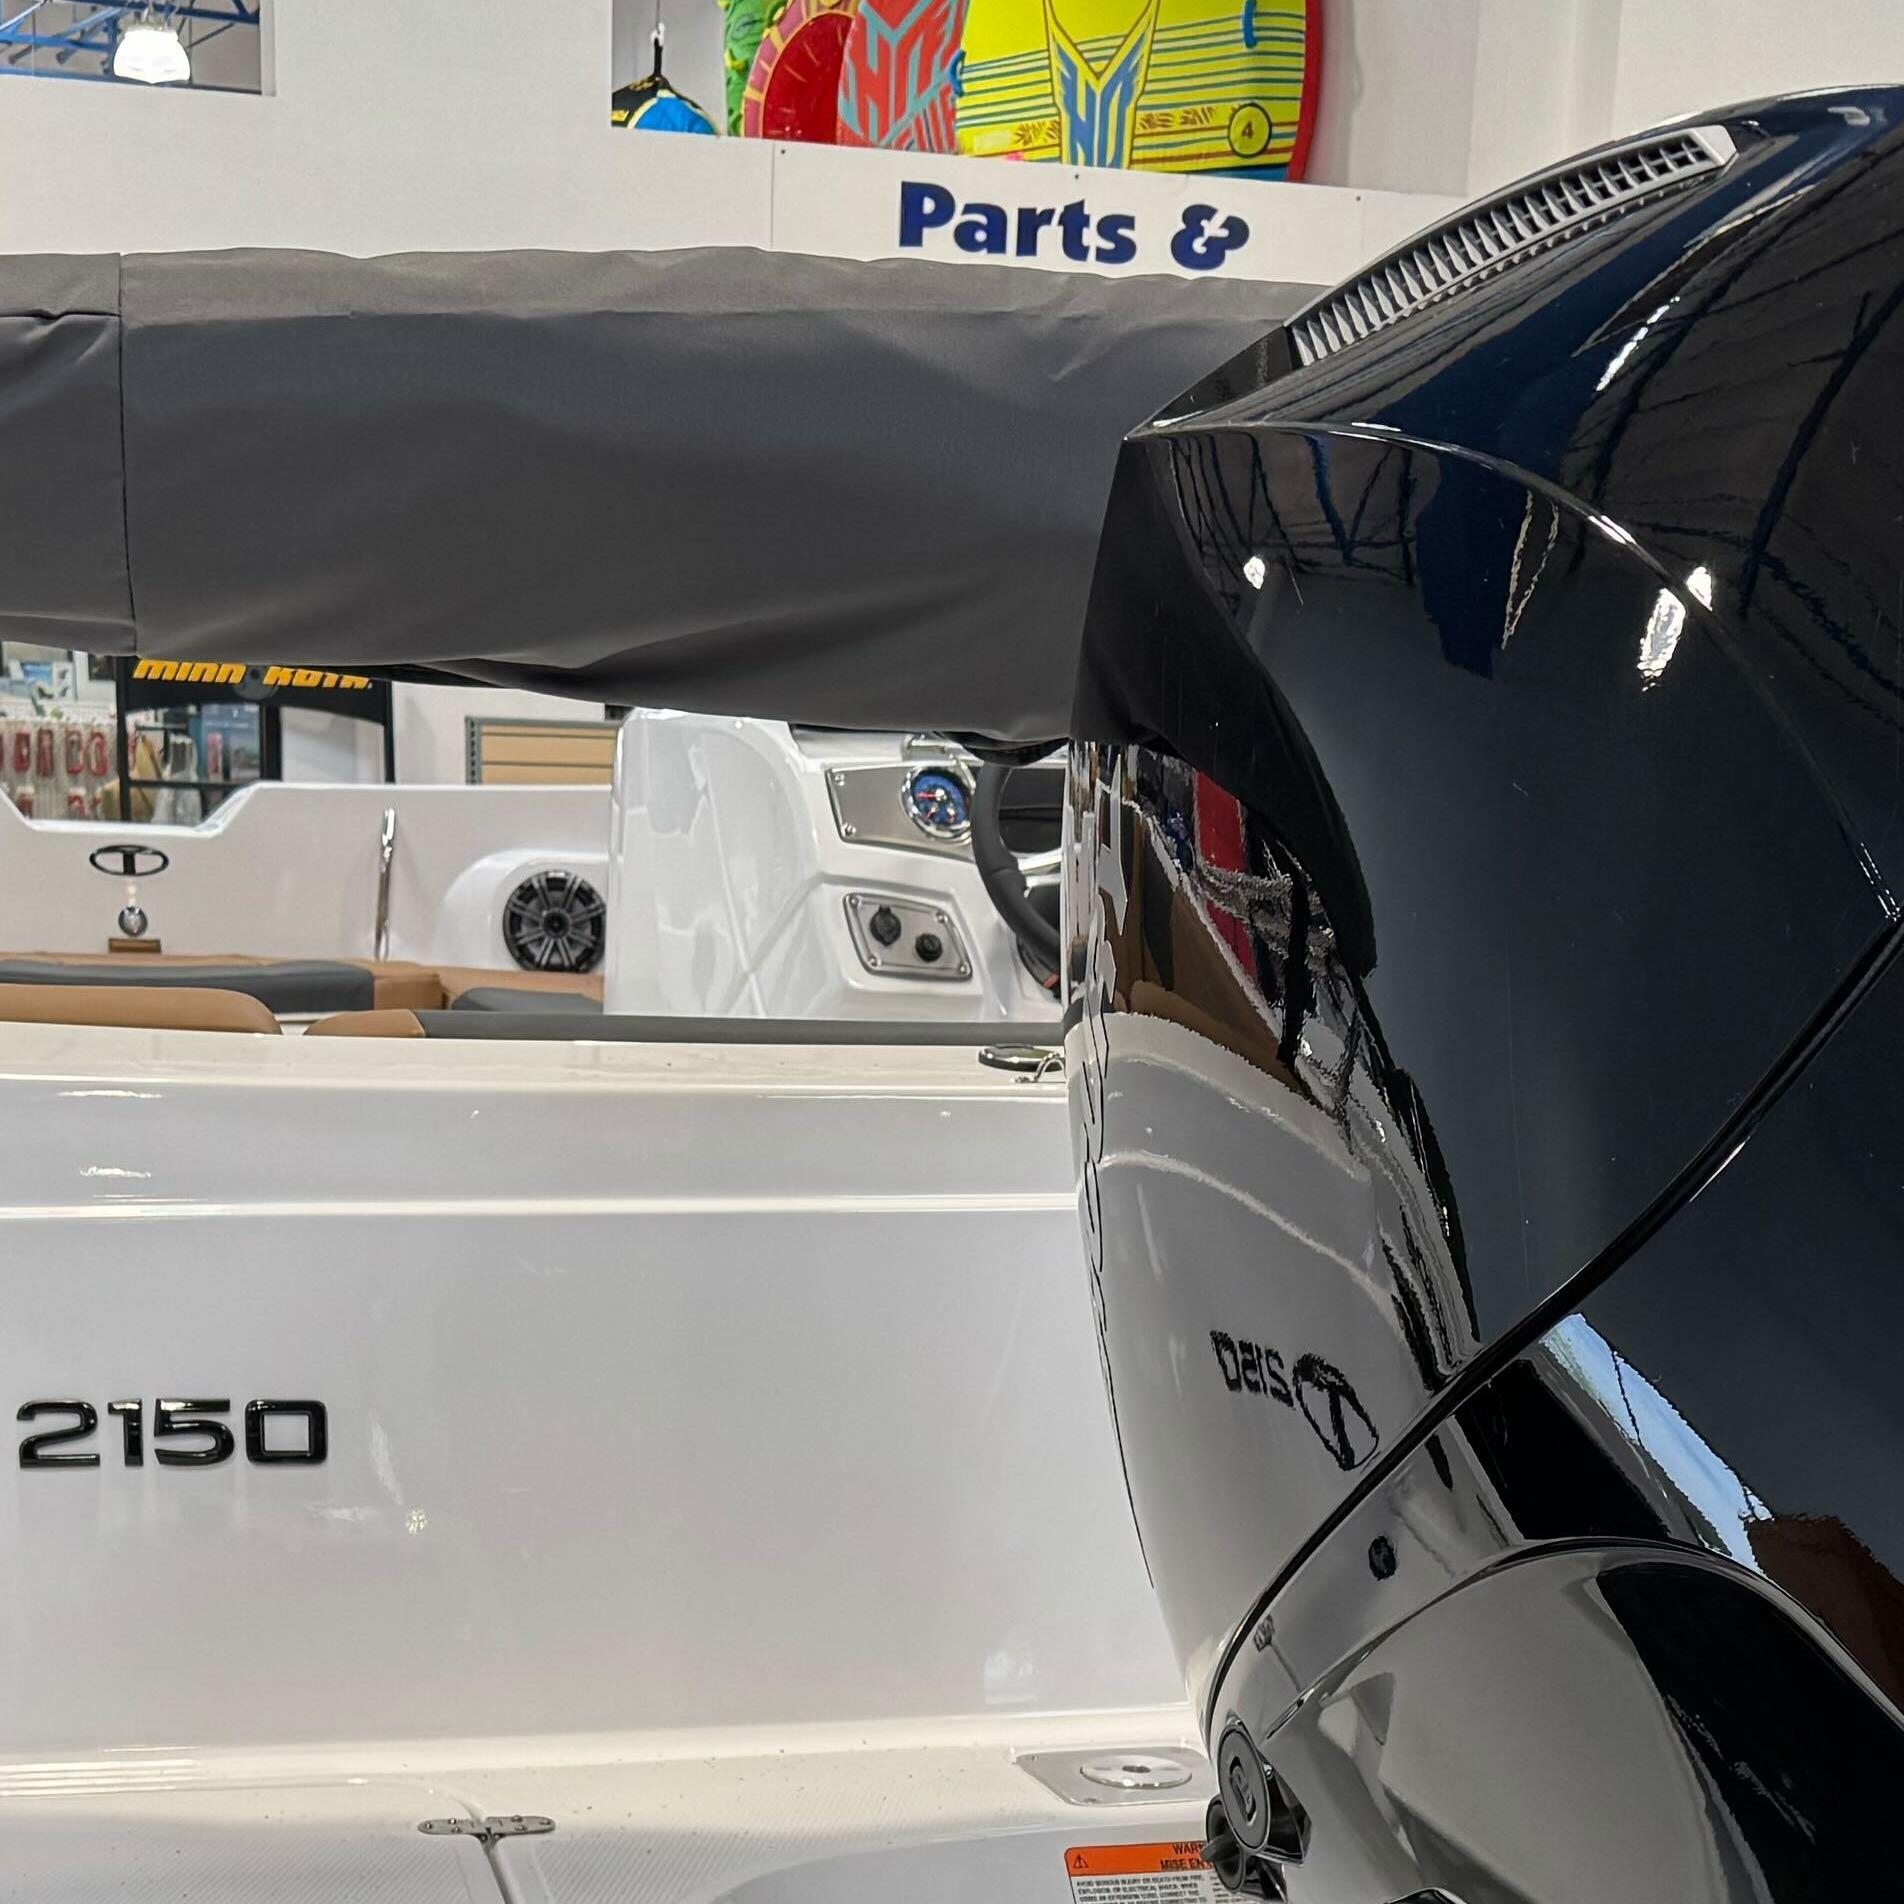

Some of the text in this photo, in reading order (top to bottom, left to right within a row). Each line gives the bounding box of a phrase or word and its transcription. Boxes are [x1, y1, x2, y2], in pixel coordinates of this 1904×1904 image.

[899, 181, 1250, 271] Parts &
[16, 1398, 328, 1468] 2150
